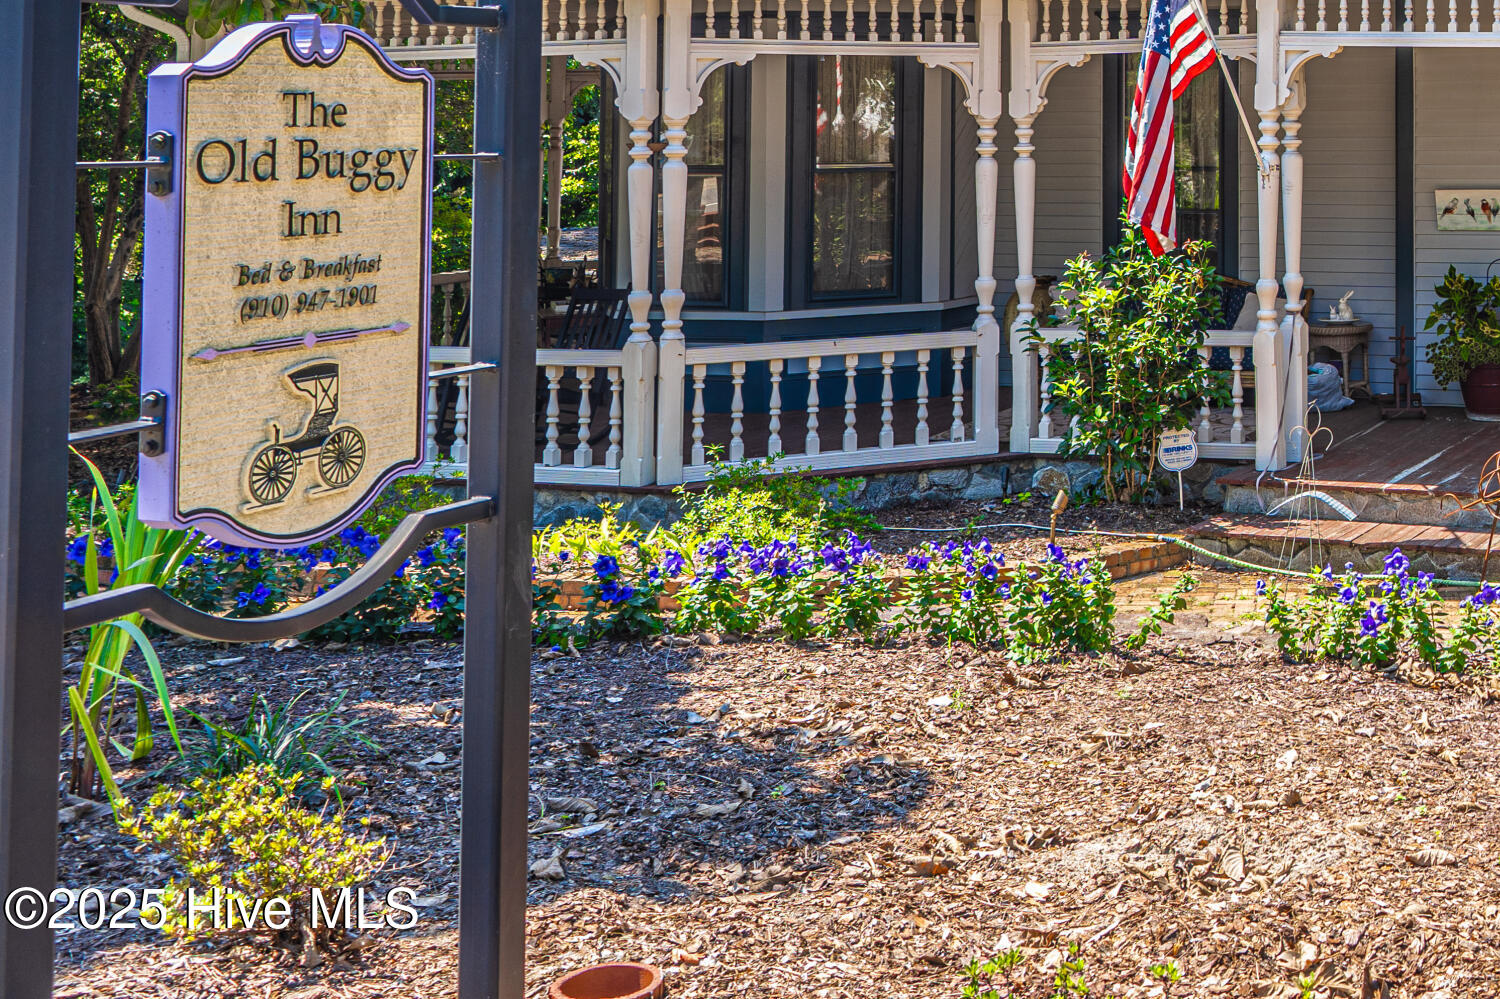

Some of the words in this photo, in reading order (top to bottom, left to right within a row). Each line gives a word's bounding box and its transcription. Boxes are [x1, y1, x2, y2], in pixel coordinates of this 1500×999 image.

[282, 90, 348, 128] The
[195, 137, 279, 184] Old
[294, 136, 419, 193] Buggy
[282, 200, 343, 238] Inn
[235, 262, 273, 287] Bed
[278, 260, 297, 282] &
[301, 253, 382, 283] Breakfast
[240, 293, 290, 325] (910)
[294, 284, 378, 314] 947-1901
